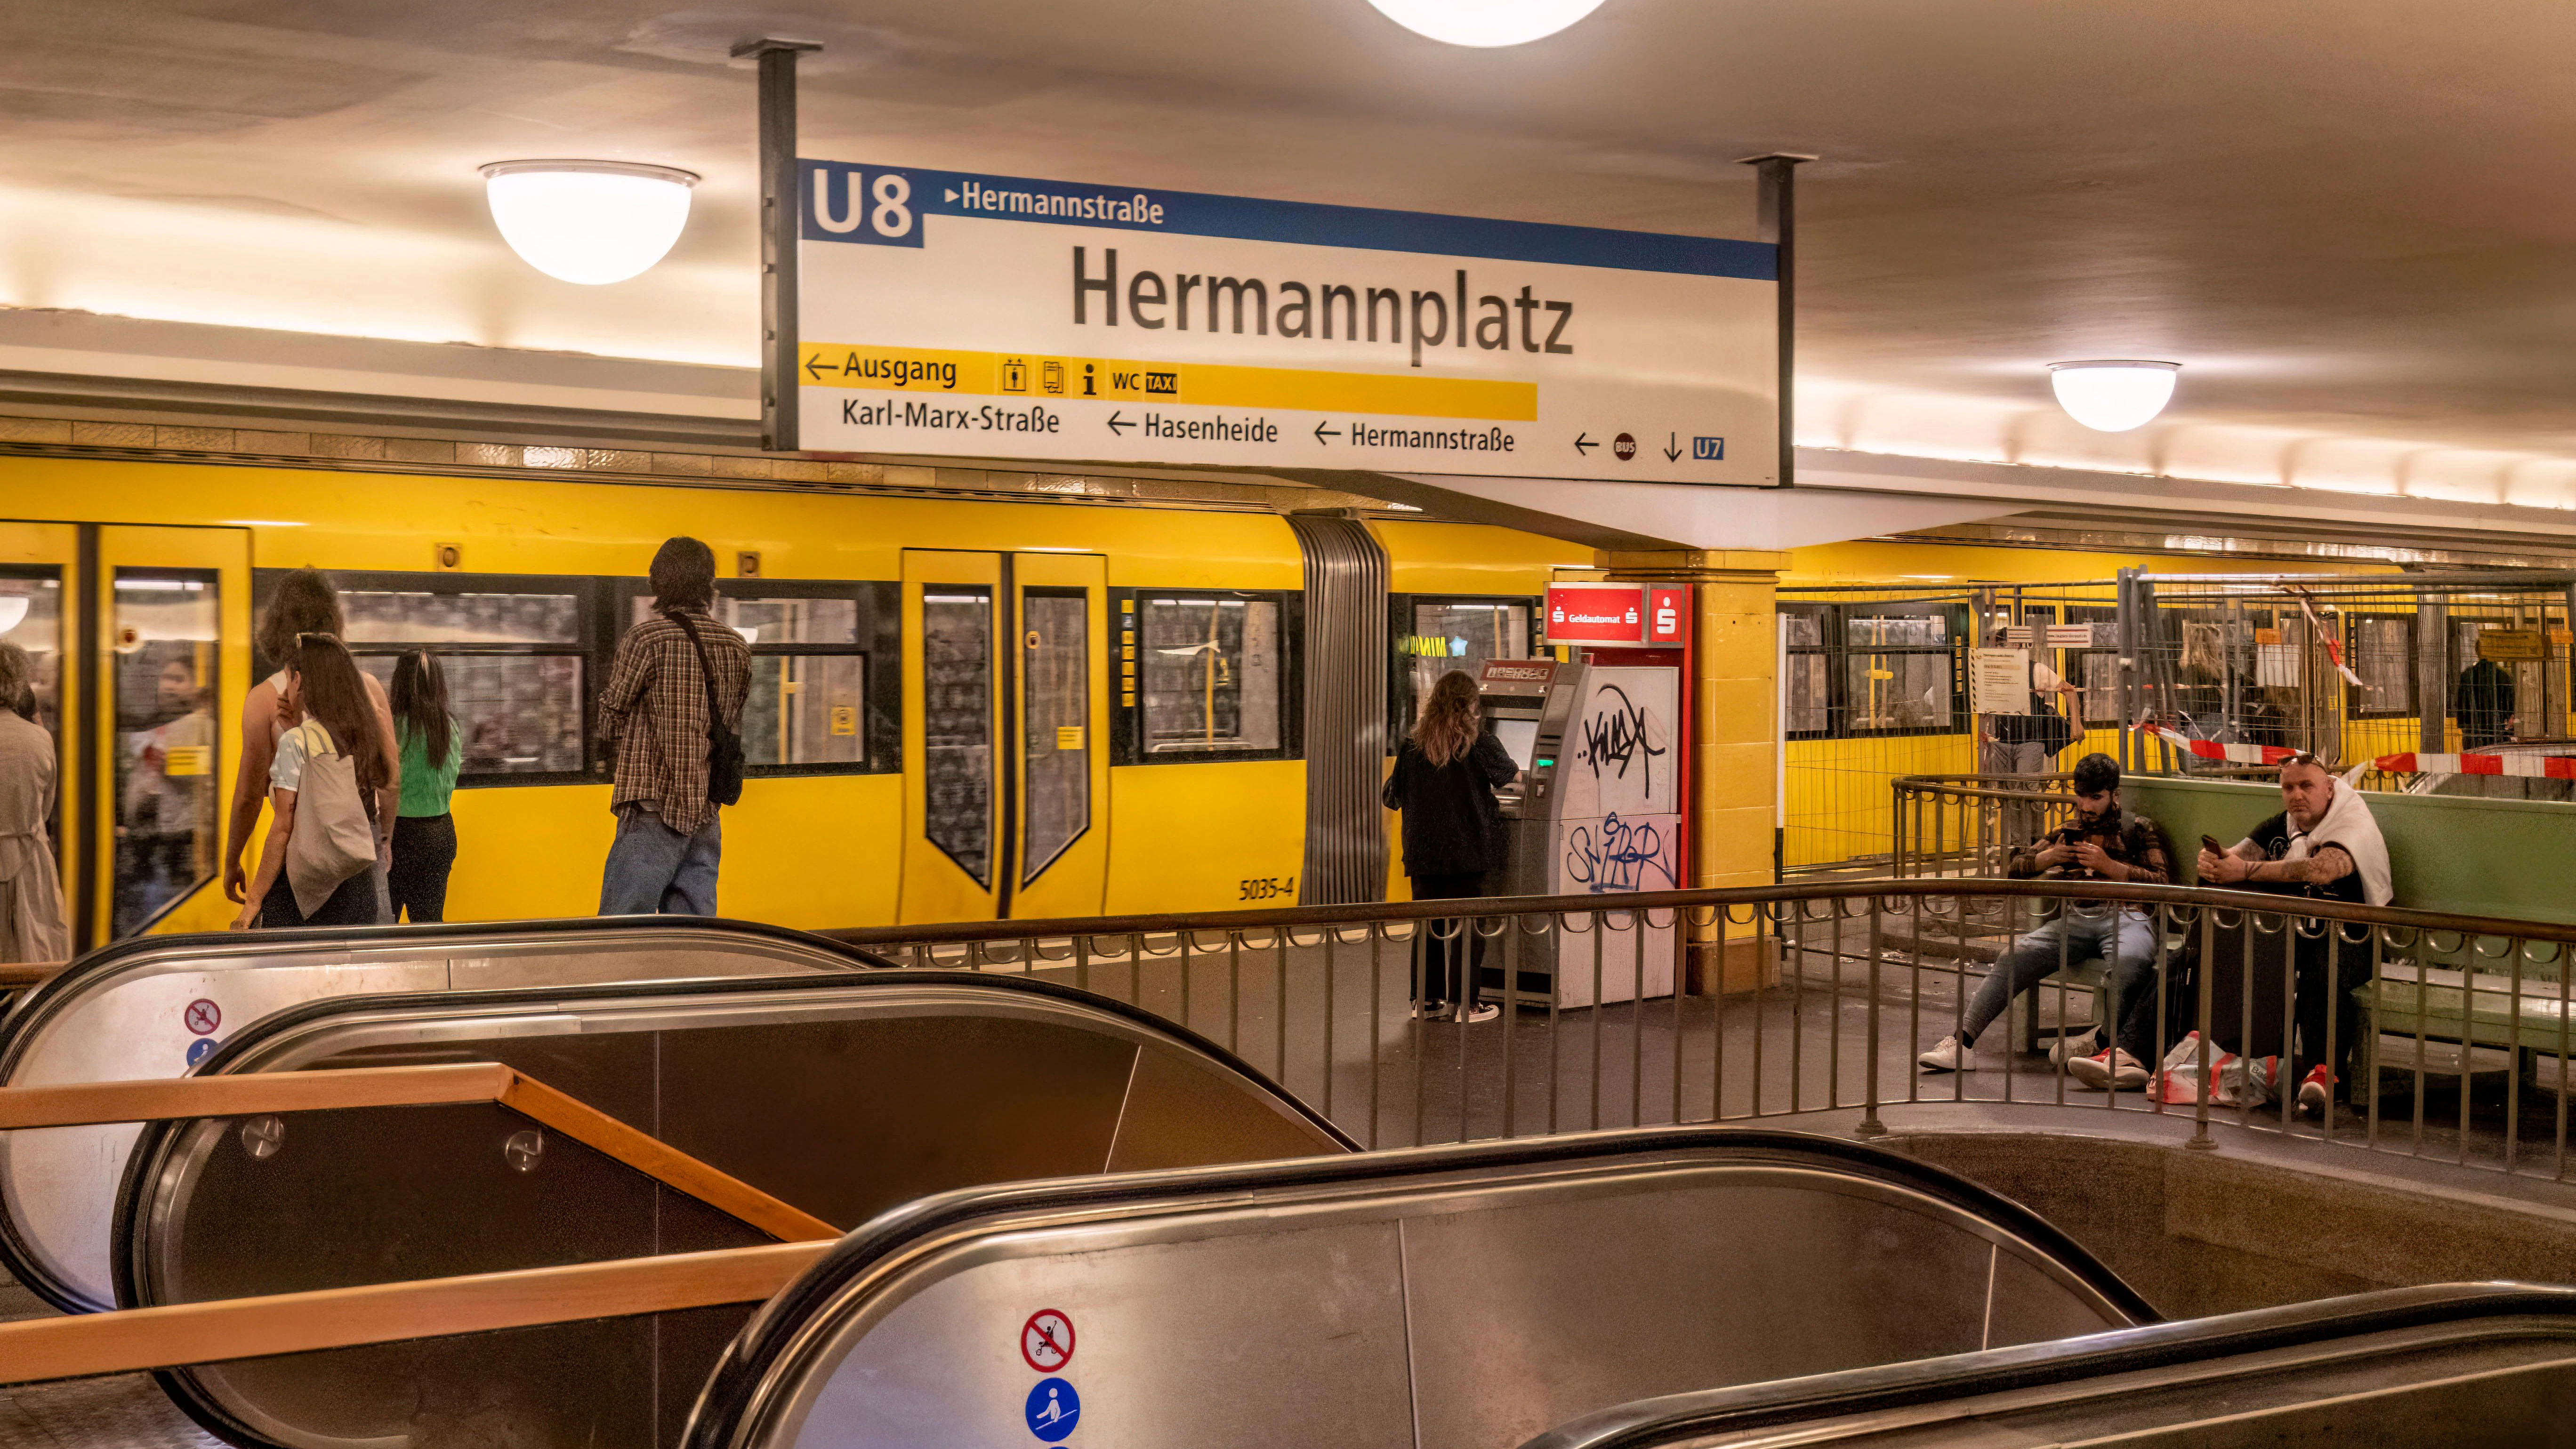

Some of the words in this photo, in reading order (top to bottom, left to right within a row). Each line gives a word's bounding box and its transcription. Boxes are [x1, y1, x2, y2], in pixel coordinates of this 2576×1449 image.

[813, 169, 912, 238] U8
[962, 181, 1164, 225] Hermannstraße
[1073, 246, 1574, 368] Hermannplatz
[844, 351, 957, 389] Ausgang
[1112, 372, 1141, 391] WC
[1146, 373, 1177, 393] TAXI
[843, 399, 1060, 434] Karl-Marx-Straße
[1145, 413, 1278, 443] Hasenheide
[1352, 423, 1515, 453] Hermannstraße
[1615, 442, 1636, 452] BUS
[1696, 439, 1722, 458] U7
[1569, 614, 1620, 624] Geldautomat
[1239, 877, 1293, 901] 5035-4
